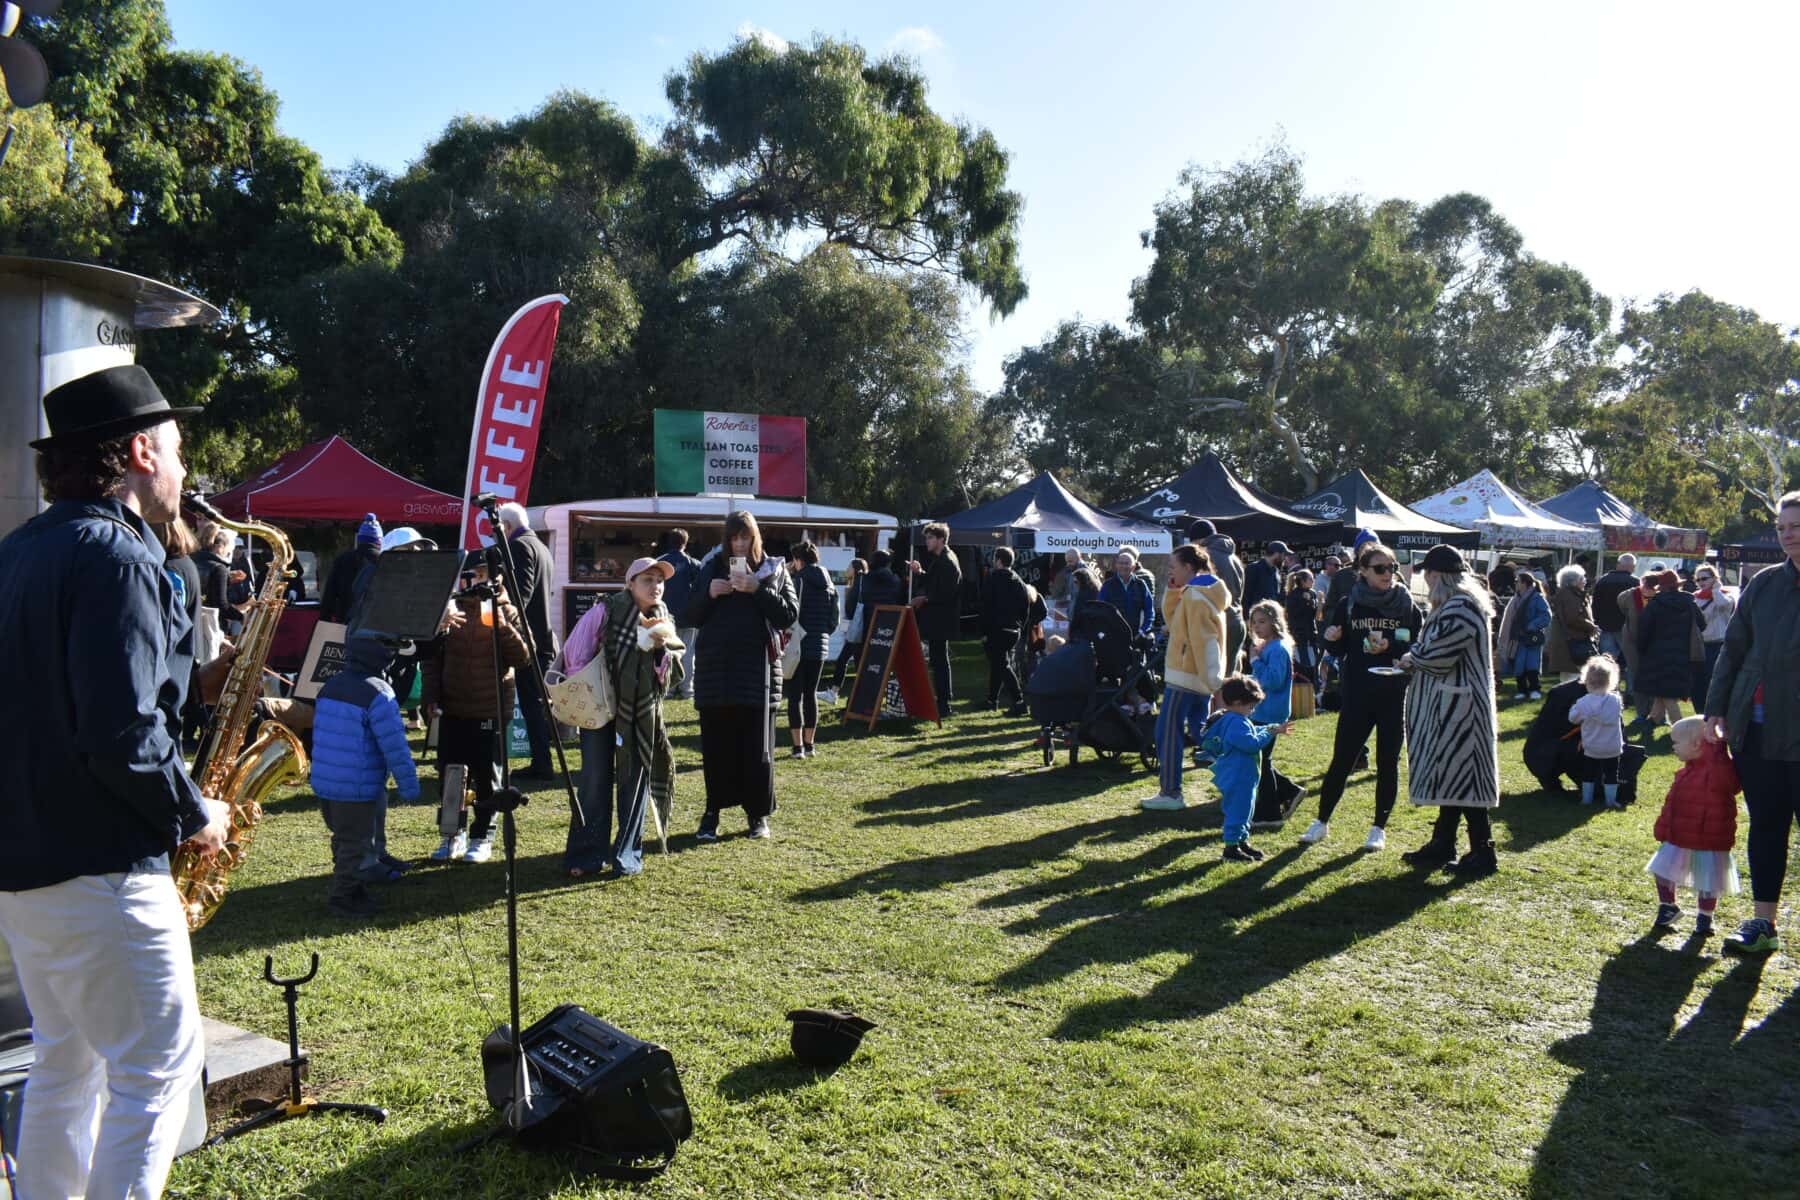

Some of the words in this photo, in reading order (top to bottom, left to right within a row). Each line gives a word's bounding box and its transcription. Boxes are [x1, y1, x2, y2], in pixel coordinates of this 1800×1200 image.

[706, 416, 757, 432] Roberta's
[680, 440, 727, 453] ITALIAN
[710, 458, 753, 470] COFFEE
[708, 475, 754, 486] DESSERT
[1047, 536, 1104, 550] Sourdough
[1107, 537, 1160, 548] Doughnuts
[1351, 617, 1401, 630] KINDNESS
